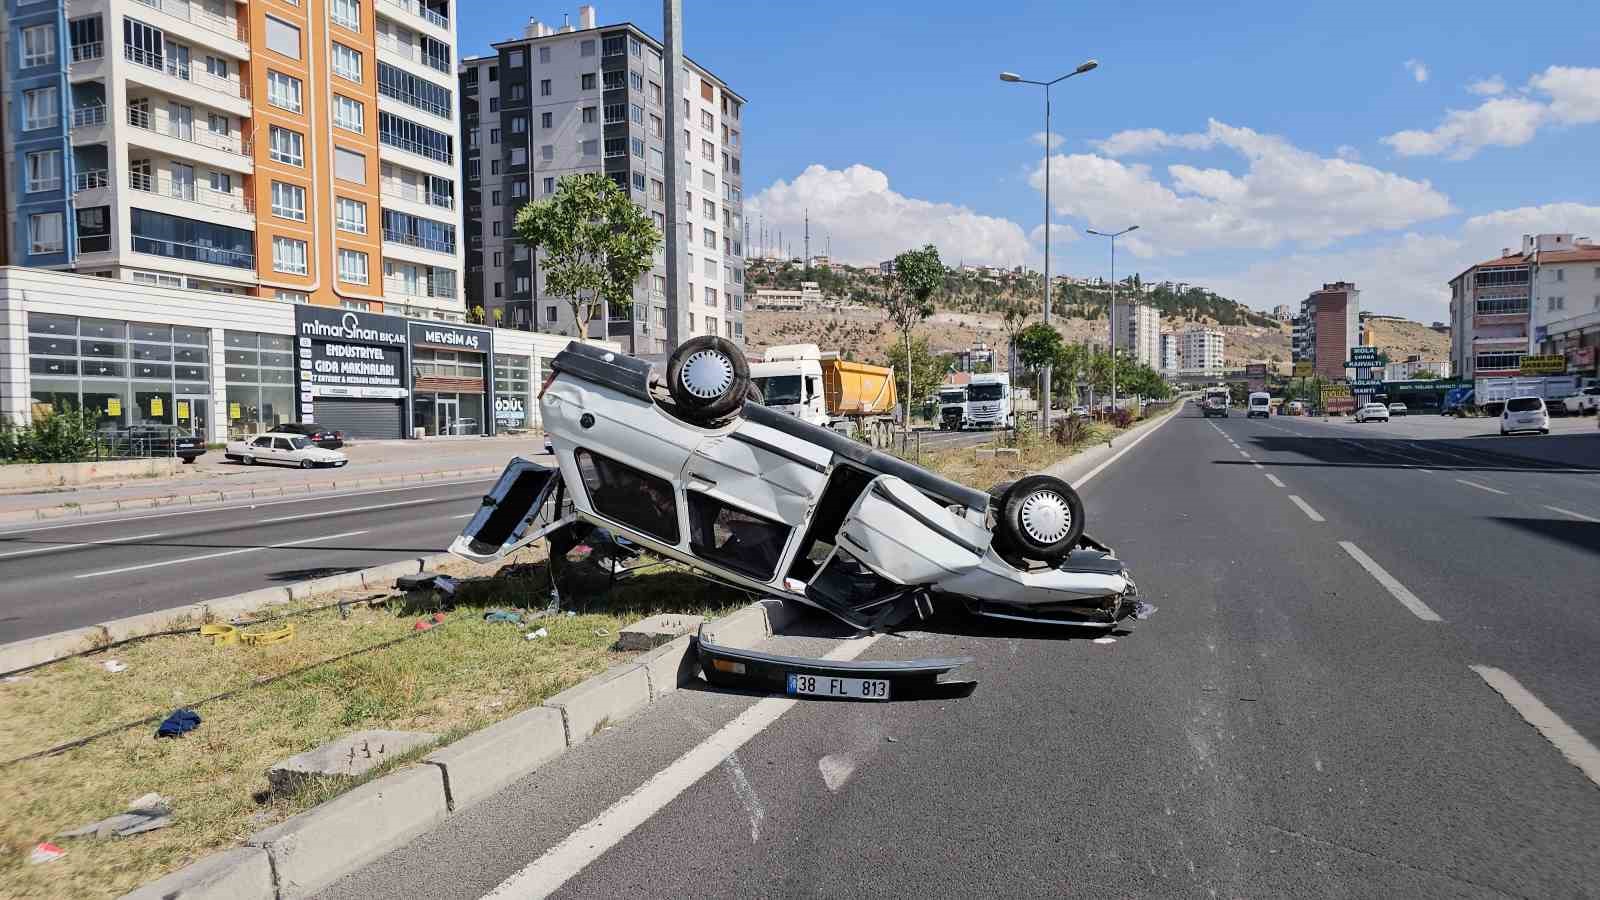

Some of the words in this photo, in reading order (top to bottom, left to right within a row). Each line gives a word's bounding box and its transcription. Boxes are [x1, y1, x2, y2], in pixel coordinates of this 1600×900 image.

[425, 330, 464, 345] MEVSİM
[465, 335, 479, 349] AŞ
[315, 360, 339, 374] GIDA
[340, 361, 395, 376] MAKİNALARI
[798, 676, 816, 693] 38
[830, 679, 848, 694] FL
[862, 680, 886, 697] 813
